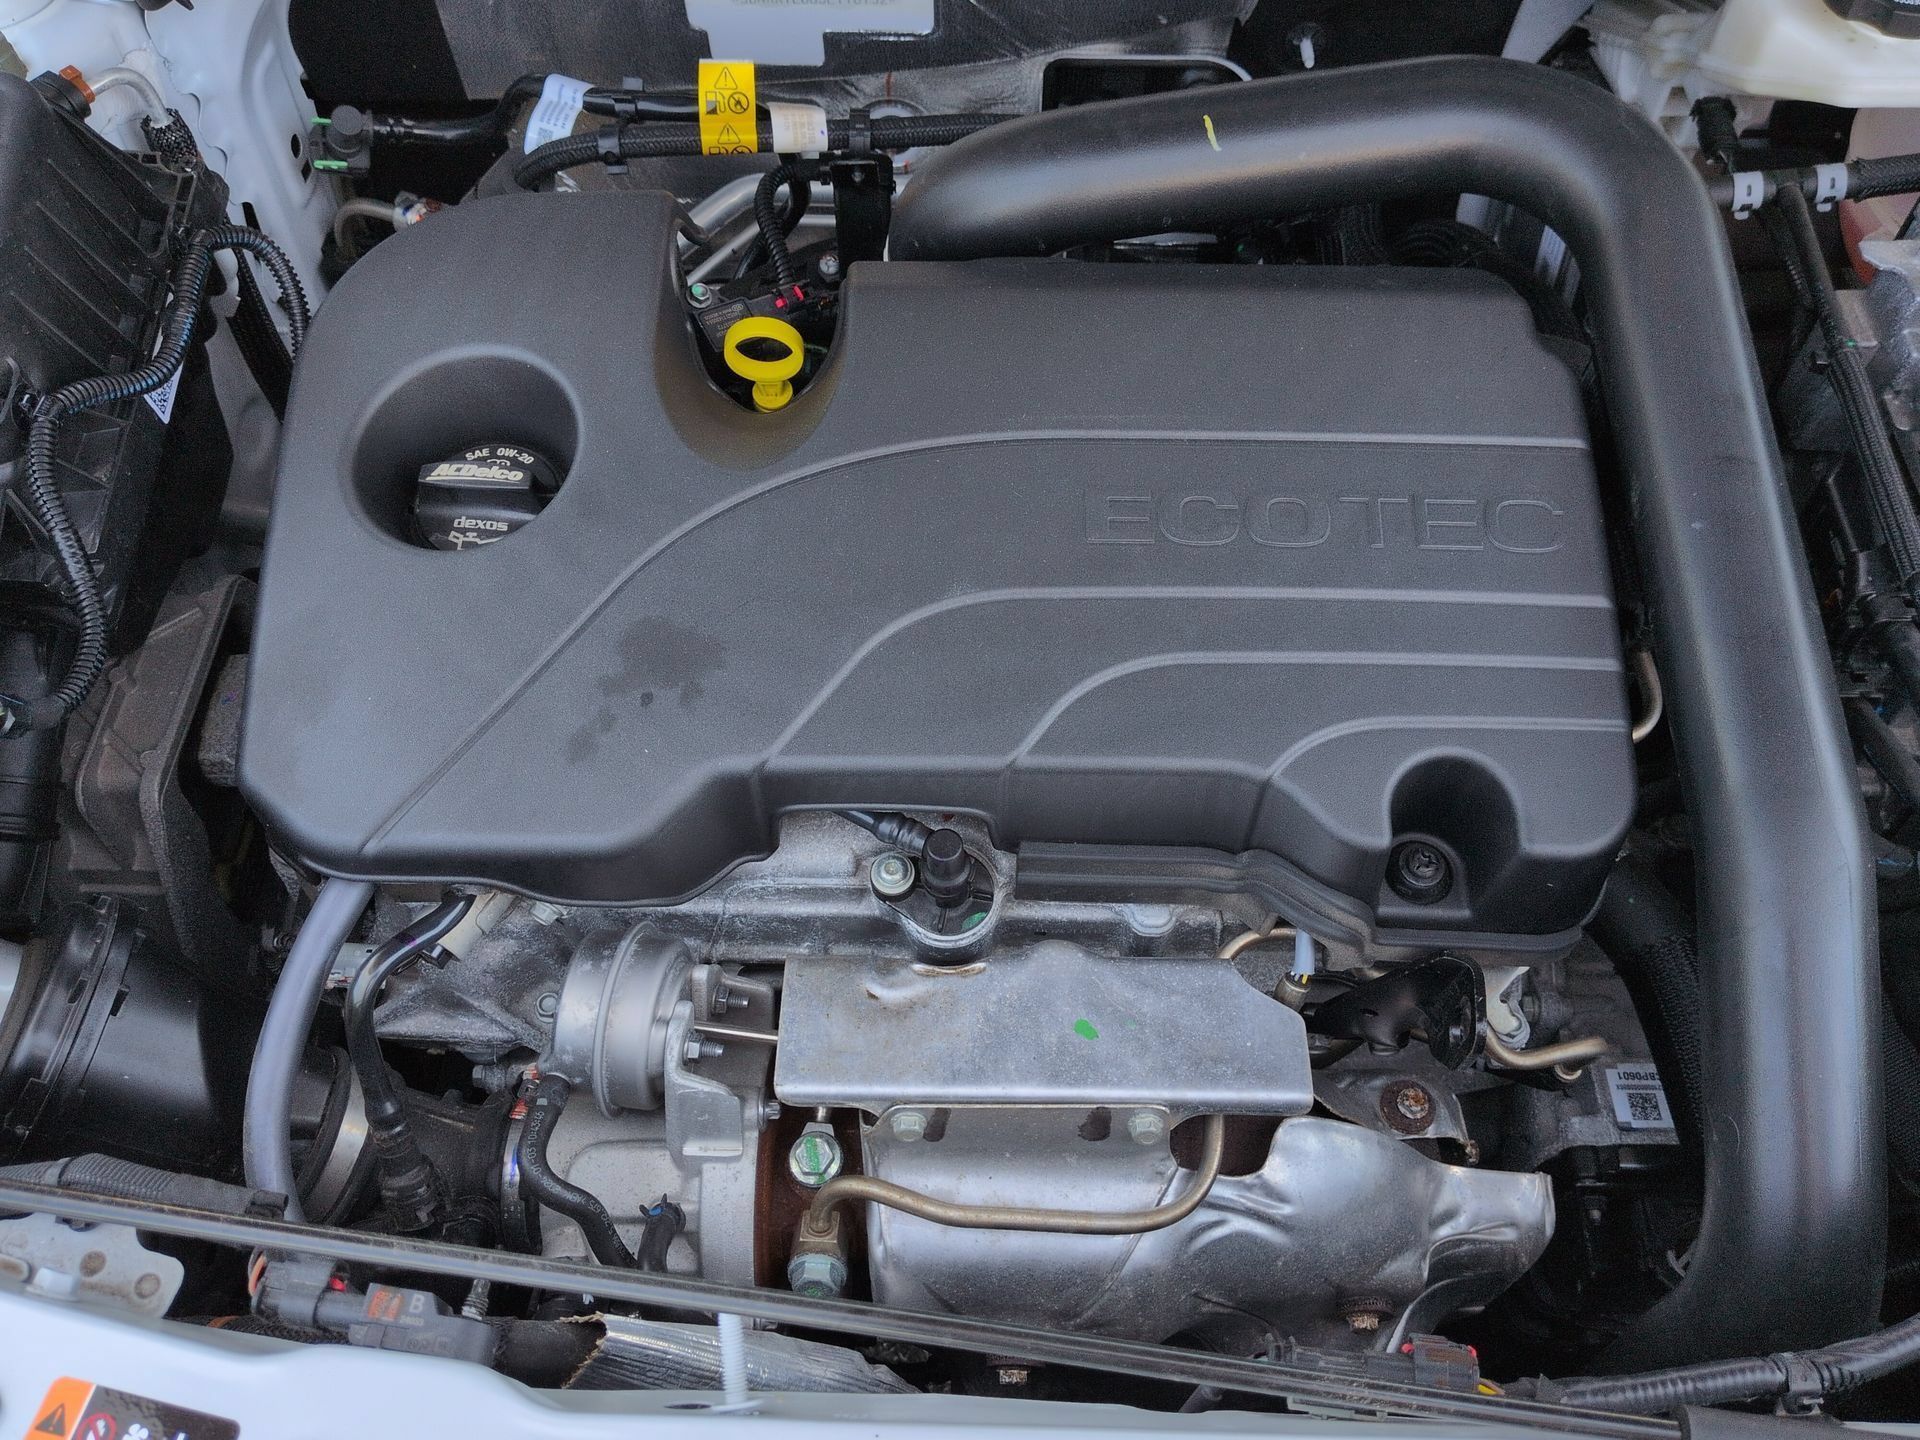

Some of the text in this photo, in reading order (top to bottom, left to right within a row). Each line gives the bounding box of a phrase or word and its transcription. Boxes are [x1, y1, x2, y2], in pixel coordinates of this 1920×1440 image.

[465, 447, 535, 465] SAE 0W-20
[430, 464, 524, 481] ACDelco
[453, 516, 509, 531] dexos
[1085, 494, 1565, 553] ECOTEC
[409, 1293, 425, 1313] B
